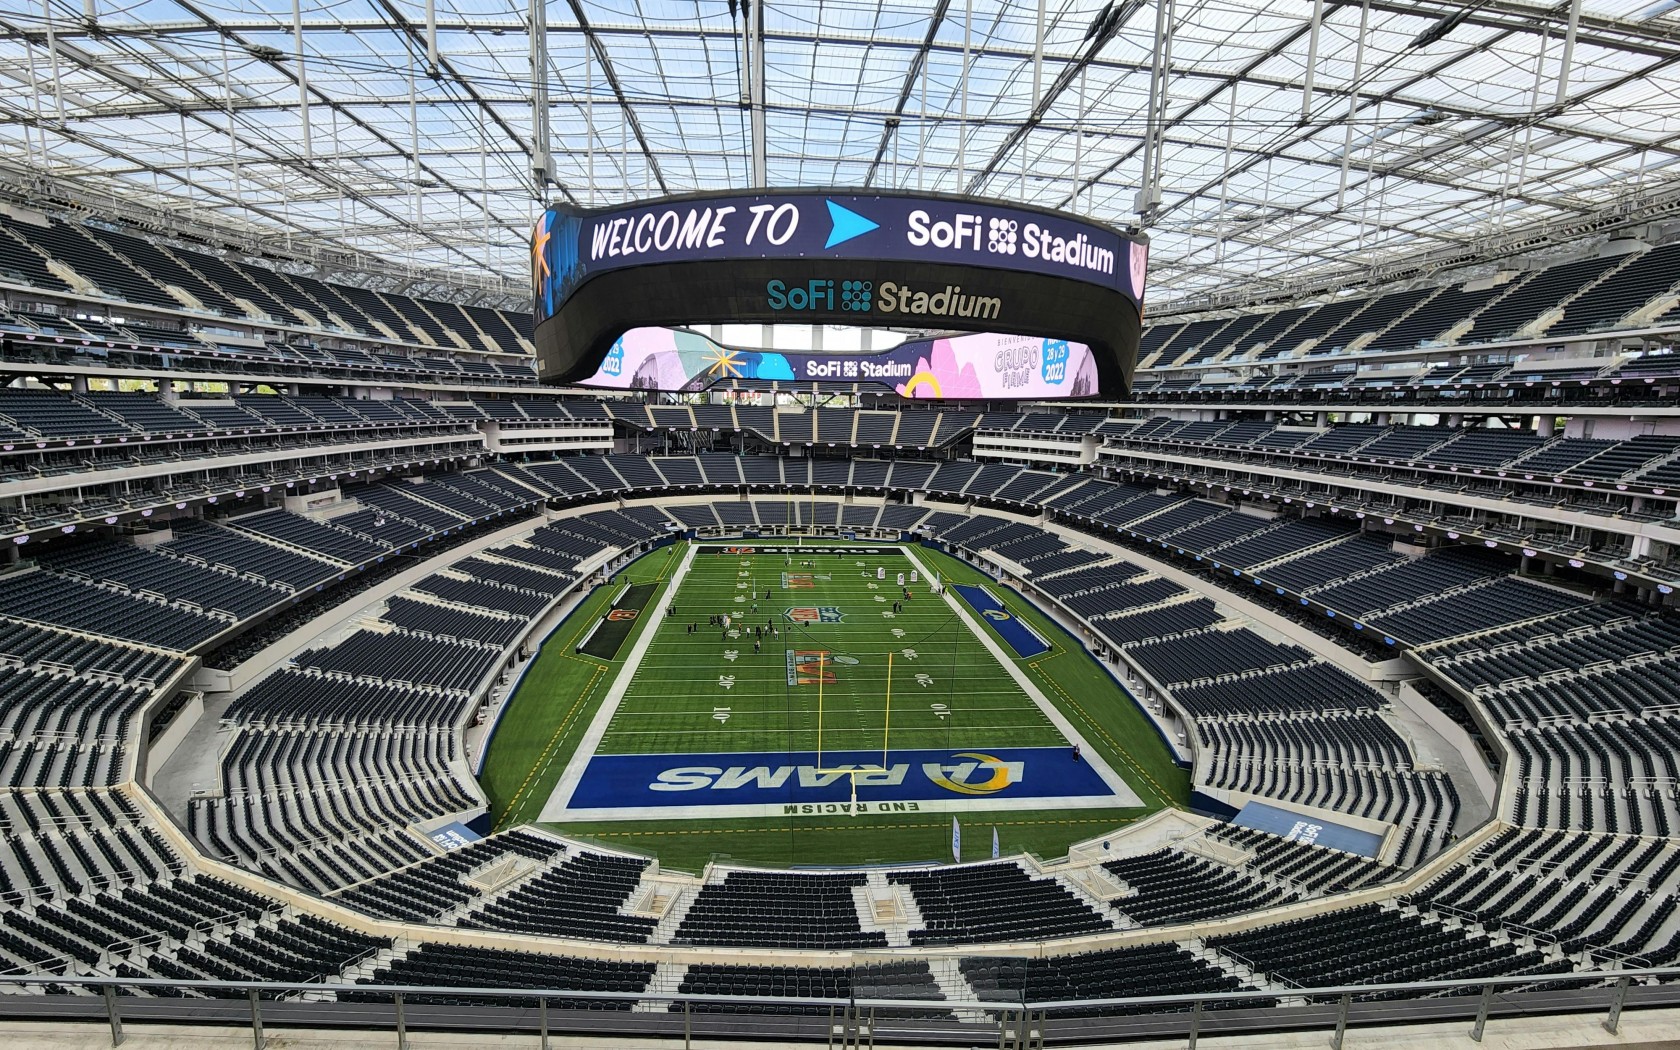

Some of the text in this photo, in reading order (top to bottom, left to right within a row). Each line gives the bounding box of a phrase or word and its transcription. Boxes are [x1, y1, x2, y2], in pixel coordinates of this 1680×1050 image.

[591, 202, 800, 261] WELCOME TO
[907, 210, 1115, 275] SoFi Stadium
[766, 279, 1002, 320] SoFi Stadium
[994, 345, 1040, 373] GRUPO
[1046, 347, 1054, 361] 28
[1058, 344, 1066, 359] 29
[602, 355, 620, 373] 2022
[806, 360, 912, 377] SoFi Stadium
[1045, 361, 1064, 381] 2022
[718, 674, 736, 687] 20
[914, 673, 934, 686] 20
[712, 706, 731, 720] 10
[930, 703, 952, 717] 10
[649, 763, 910, 792] RAMS
[784, 802, 920, 815] END RACISM
